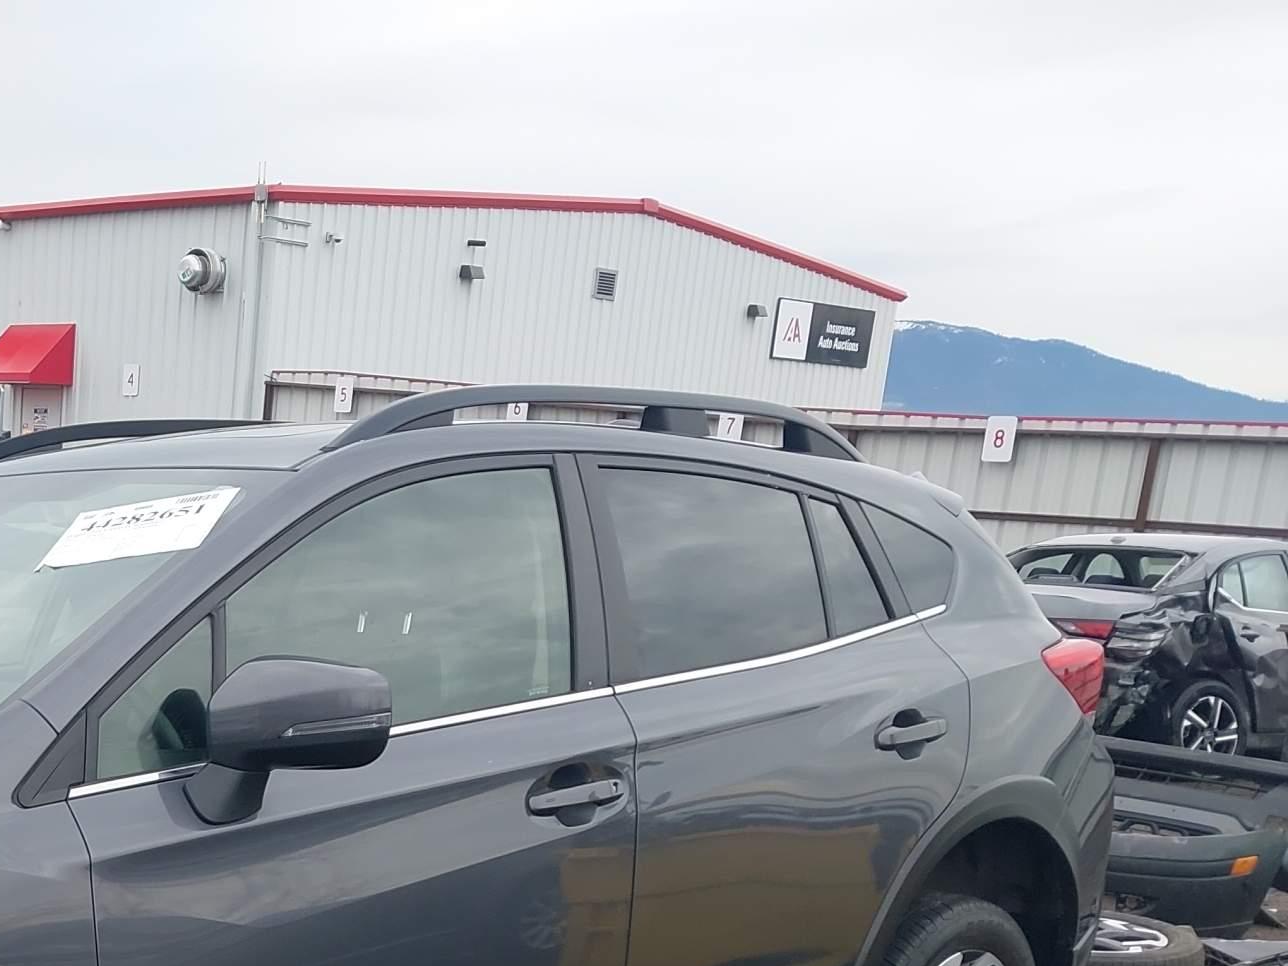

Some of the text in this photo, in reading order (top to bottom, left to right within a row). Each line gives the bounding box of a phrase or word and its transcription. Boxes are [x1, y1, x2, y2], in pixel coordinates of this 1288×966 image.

[825, 321, 856, 337] Insurance
[817, 335, 859, 352] Auto Auctions
[127, 372, 134, 387] 4
[340, 387, 347, 403] 5
[727, 417, 736, 435] 7
[993, 429, 1005, 448] 8
[80, 503, 206, 532] 44282651
